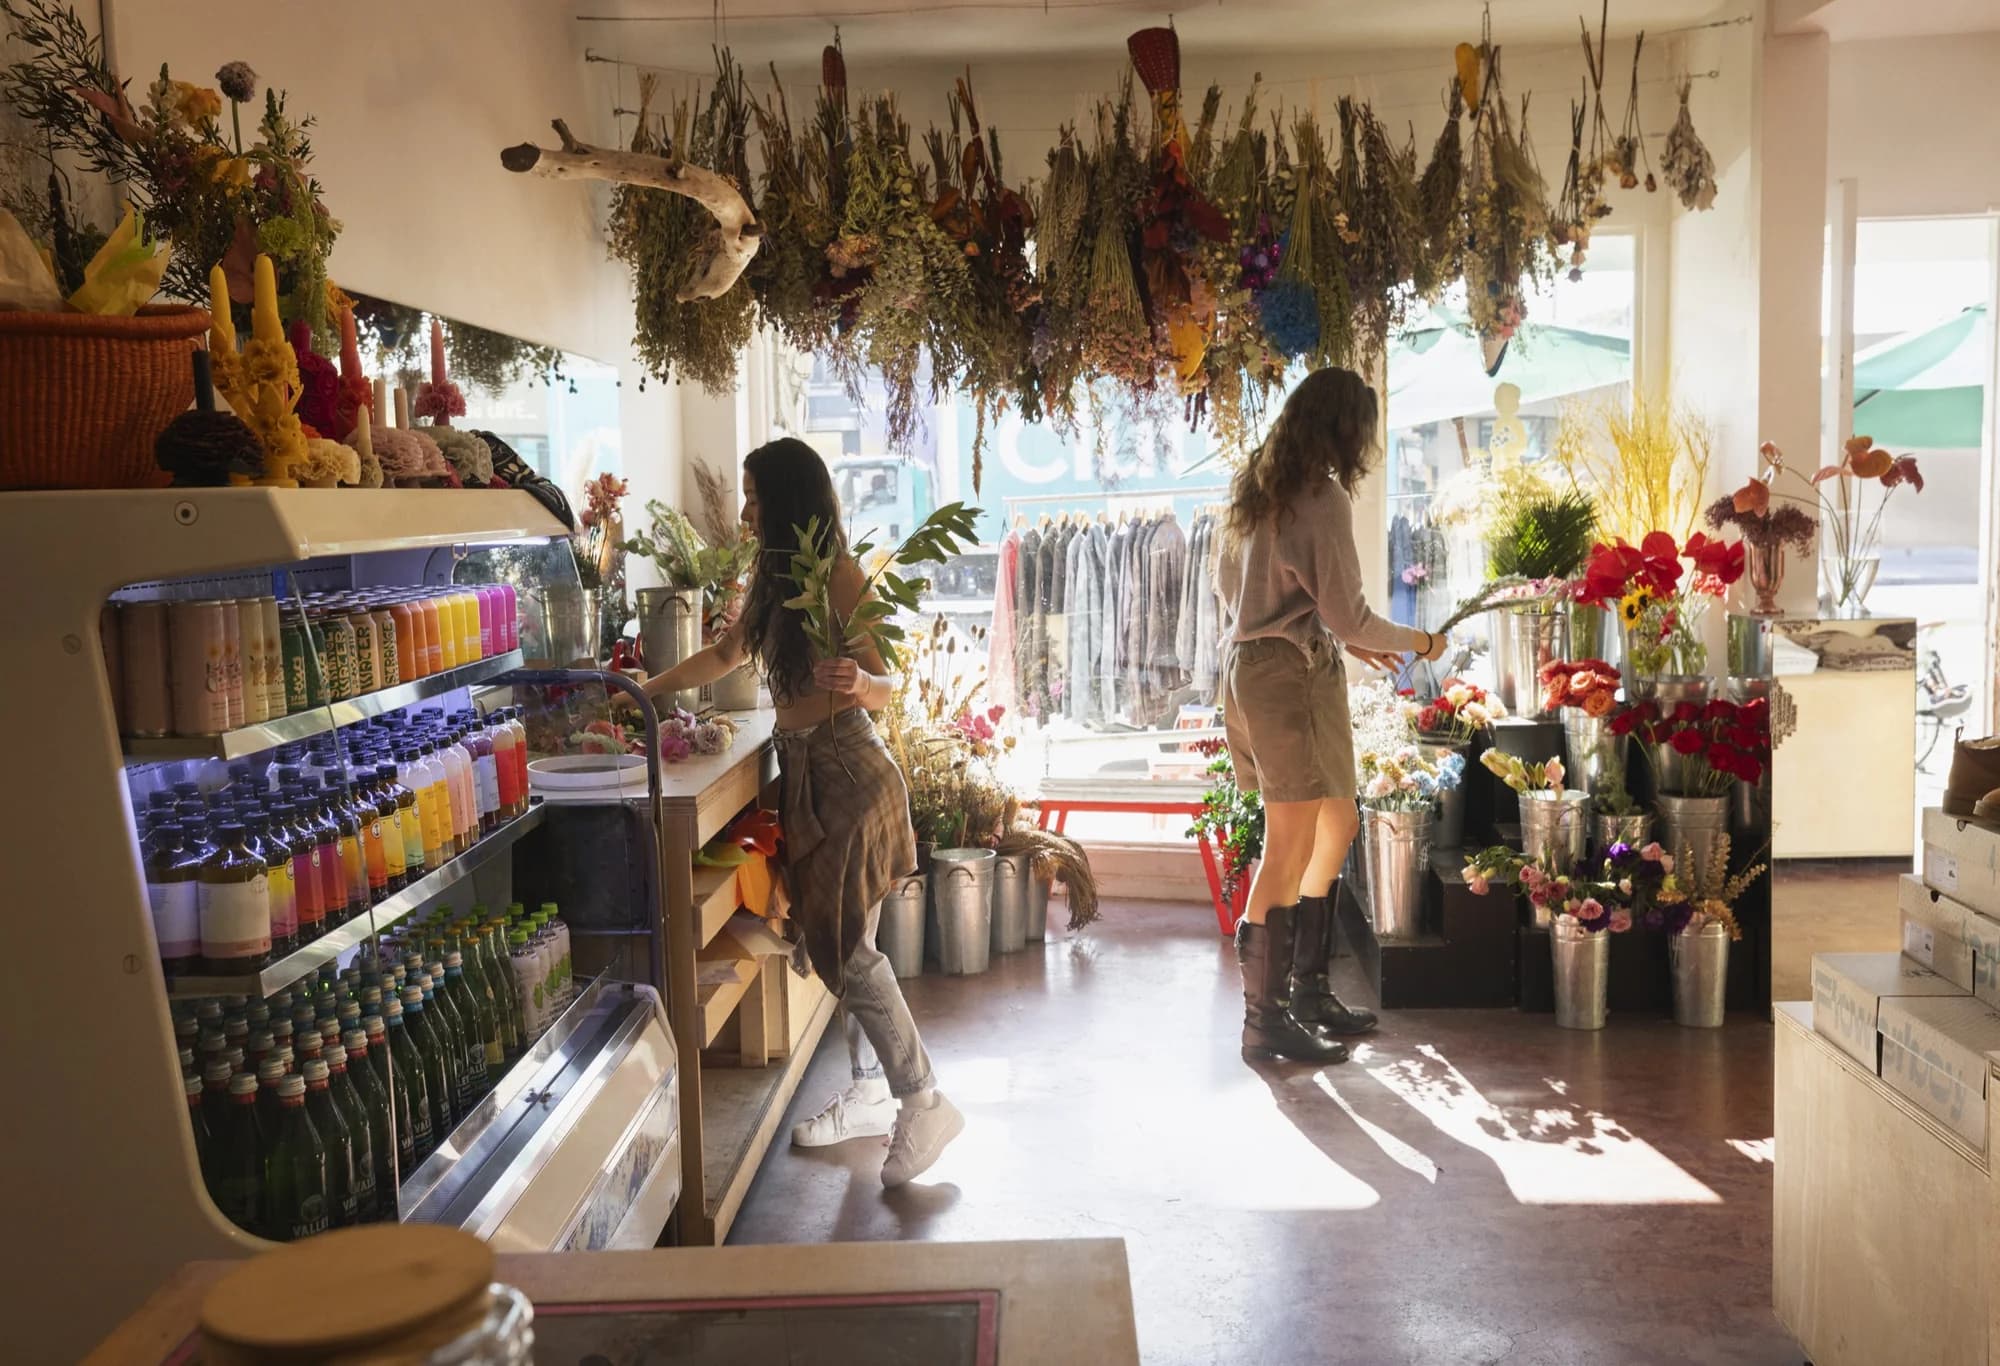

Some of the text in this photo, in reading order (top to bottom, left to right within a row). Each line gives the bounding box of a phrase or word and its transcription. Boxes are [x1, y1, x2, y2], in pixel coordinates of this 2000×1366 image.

[335, 631, 352, 697] WATER
[357, 626, 374, 689] WATER
[382, 622, 396, 684] STRANGE
